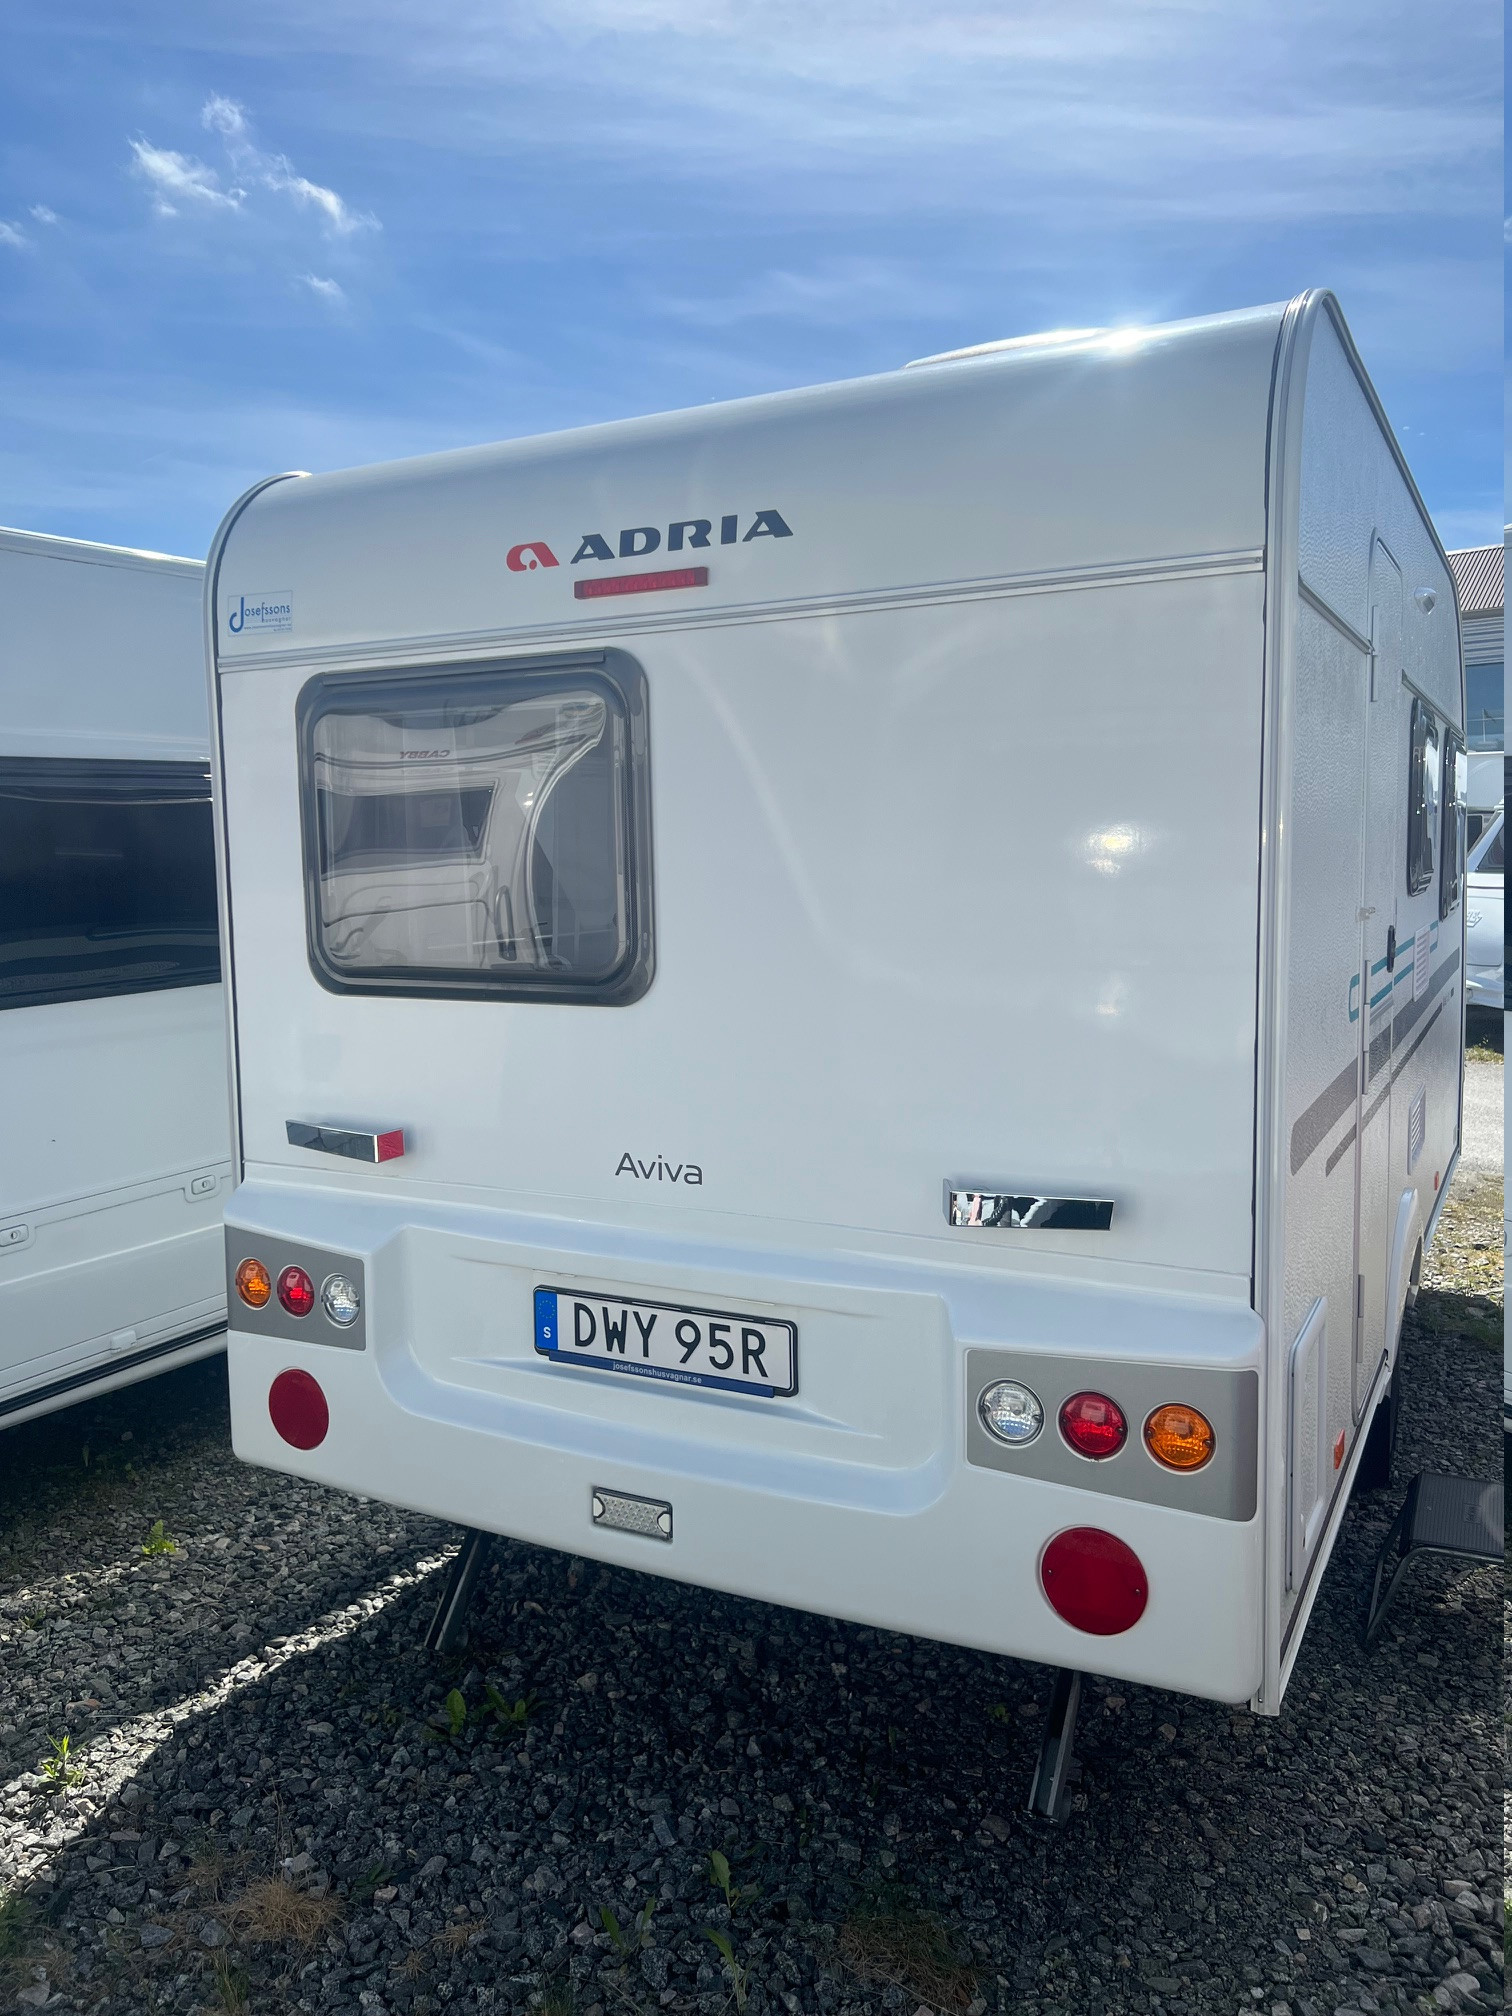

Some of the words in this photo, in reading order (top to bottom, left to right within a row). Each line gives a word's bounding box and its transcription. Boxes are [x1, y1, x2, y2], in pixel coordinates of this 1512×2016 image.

[570, 509, 794, 564] ADRIA
[229, 597, 291, 633] Josefssons
[615, 1152, 703, 1185] Aviva
[543, 1326, 552, 1339] S
[574, 1302, 657, 1357] DWY
[675, 1319, 768, 1378] 95R
[612, 1361, 703, 1384] josefssonshusvagnar.se
